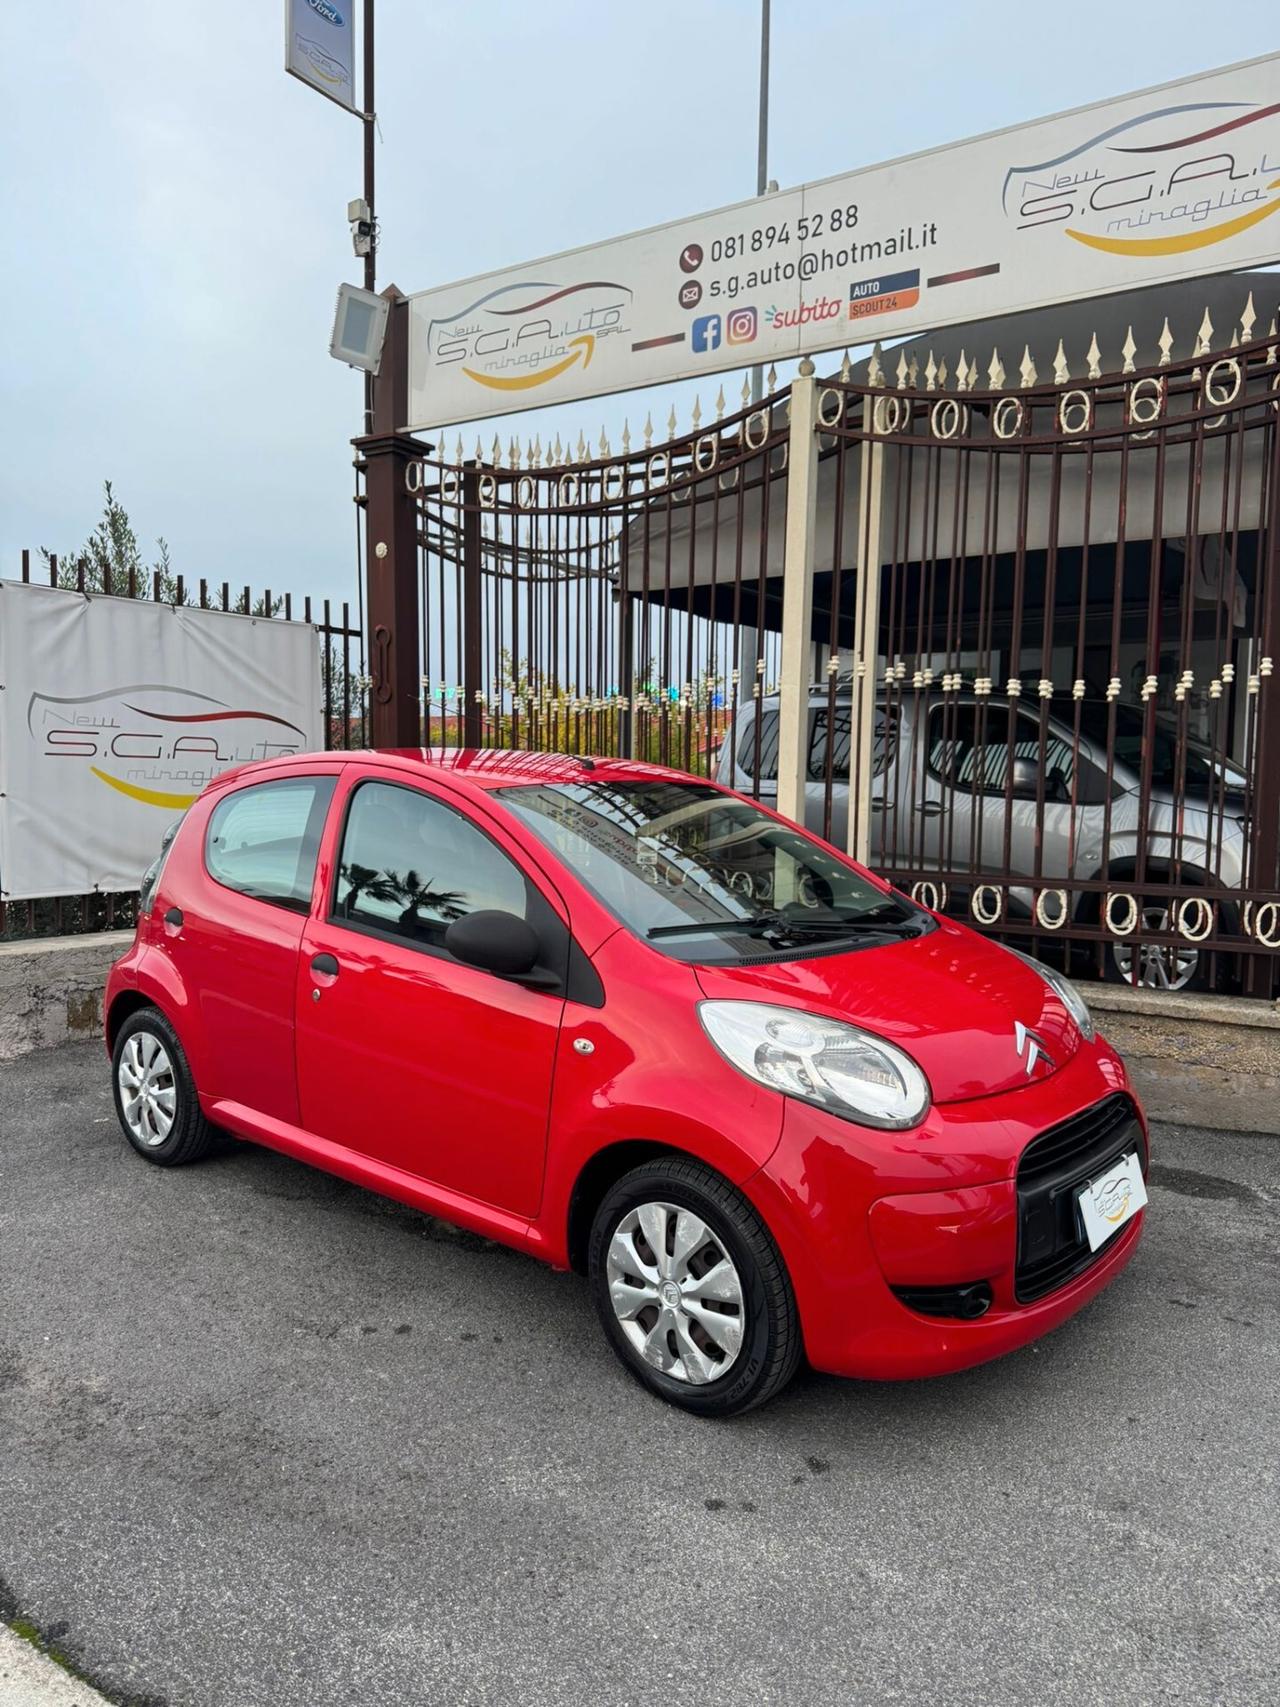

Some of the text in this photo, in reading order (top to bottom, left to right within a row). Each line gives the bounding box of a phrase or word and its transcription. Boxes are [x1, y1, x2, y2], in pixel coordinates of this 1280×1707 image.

[1106, 187, 1268, 233] miraglia
[711, 205, 858, 262] 081 894 52 88
[710, 223, 937, 297] s.g.auto@hotmail.it
[853, 281, 880, 297] AUTO
[773, 297, 842, 329] subito
[852, 299, 897, 315] SCOUT 24
[485, 345, 570, 371] miraglia
